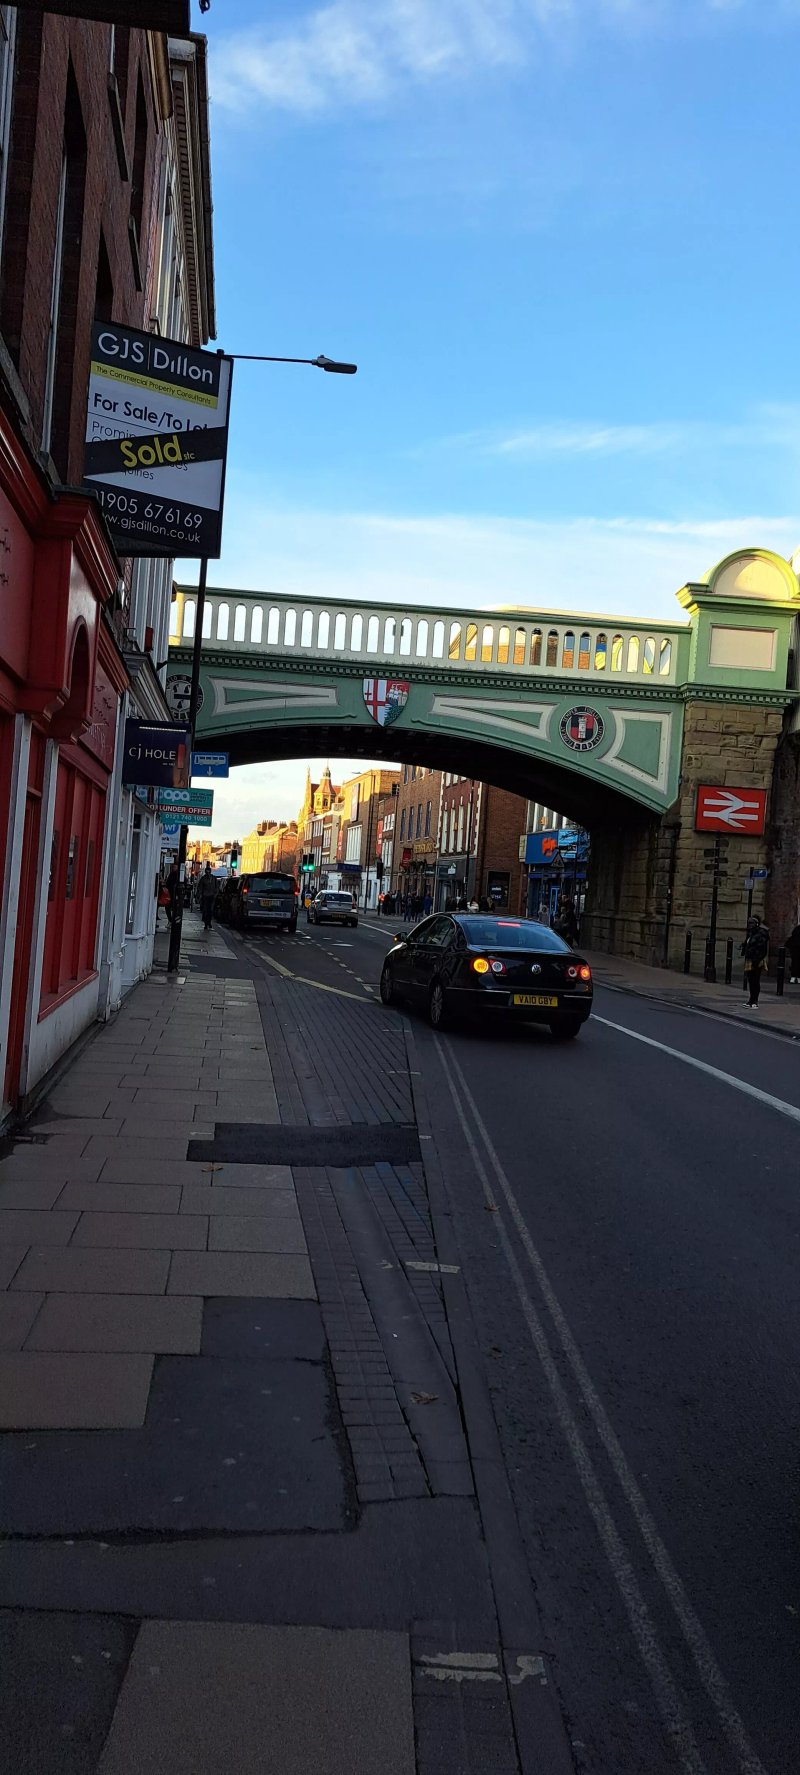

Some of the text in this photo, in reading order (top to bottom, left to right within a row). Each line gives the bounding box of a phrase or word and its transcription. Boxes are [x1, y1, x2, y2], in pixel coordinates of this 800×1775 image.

[98, 332, 213, 384] GJS Dillon
[96, 366, 211, 405] The Commercial Property Consultants
[93, 392, 119, 412] For
[120, 434, 182, 468] Sold
[183, 451, 196, 460] stc
[96, 487, 138, 514] 1905
[145, 748, 176, 760] HOLE
[162, 805, 186, 813] UNDER
[188, 807, 211, 815] OFFER
[518, 996, 553, 1005] VA10 GBY
